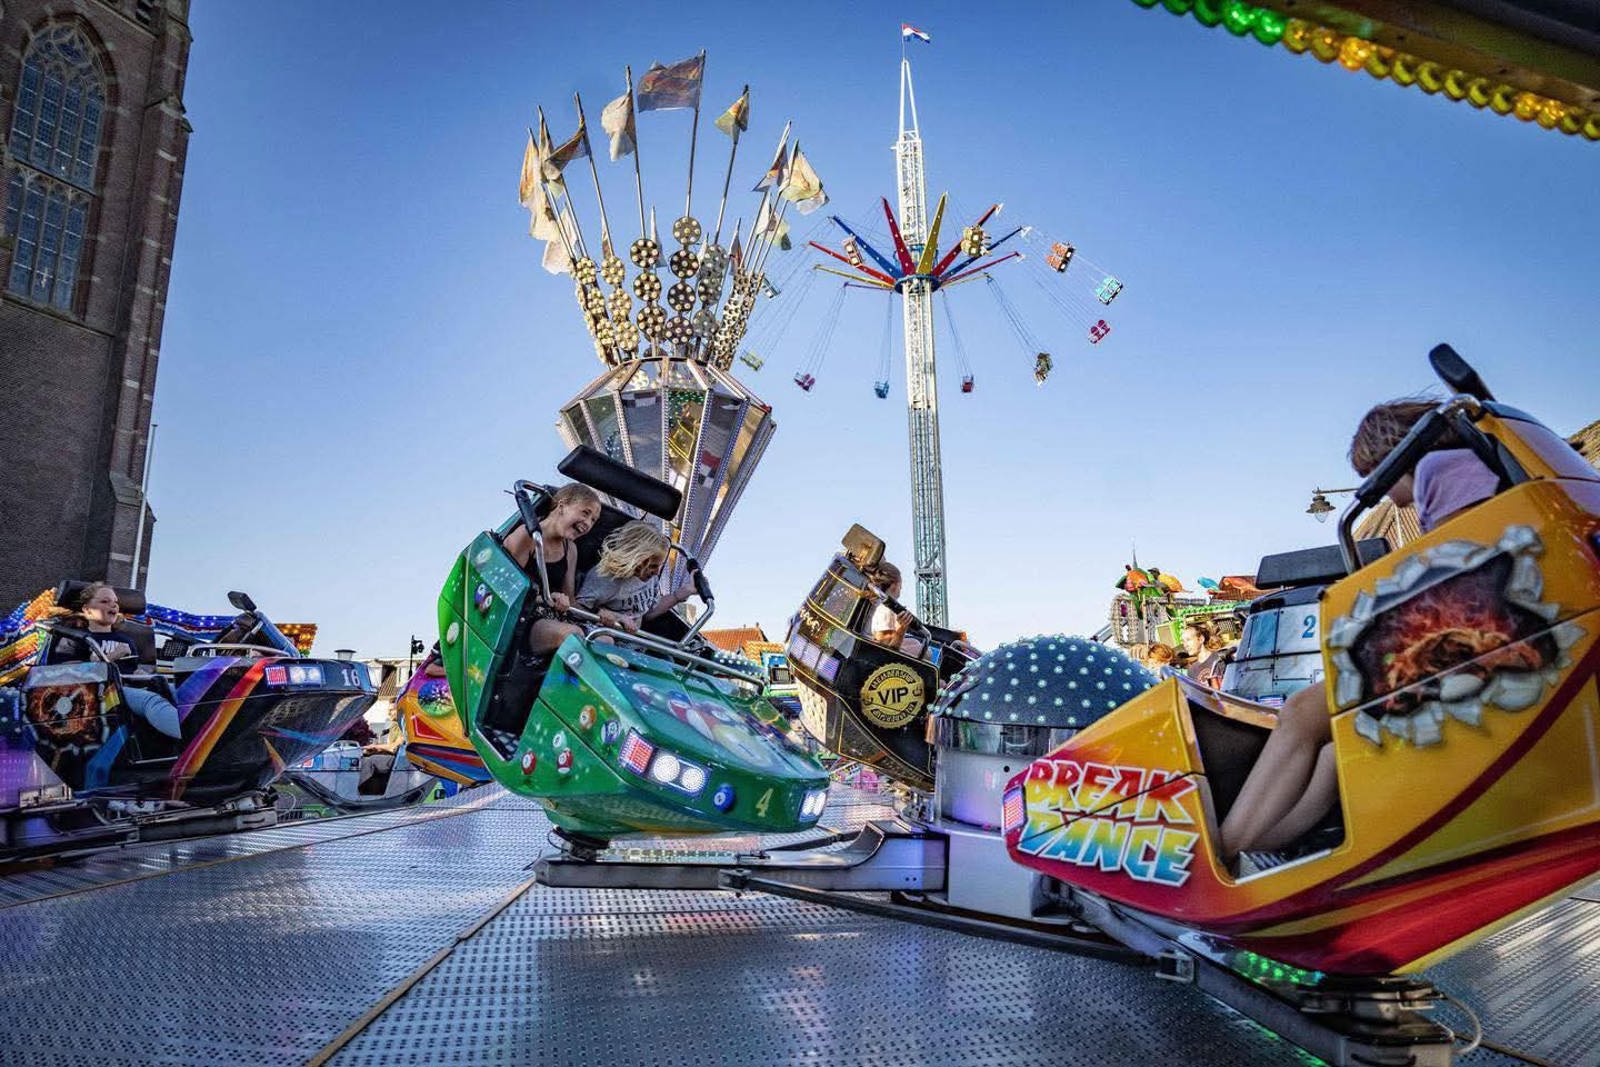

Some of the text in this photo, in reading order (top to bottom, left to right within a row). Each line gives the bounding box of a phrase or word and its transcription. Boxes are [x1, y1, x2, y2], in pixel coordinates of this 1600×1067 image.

[1302, 615, 1317, 638] 2
[341, 668, 361, 687] 16
[877, 686, 909, 705] VIP
[755, 787, 775, 818] 4
[1023, 758, 1198, 825] BREAK
[1017, 809, 1201, 888] DANCE
